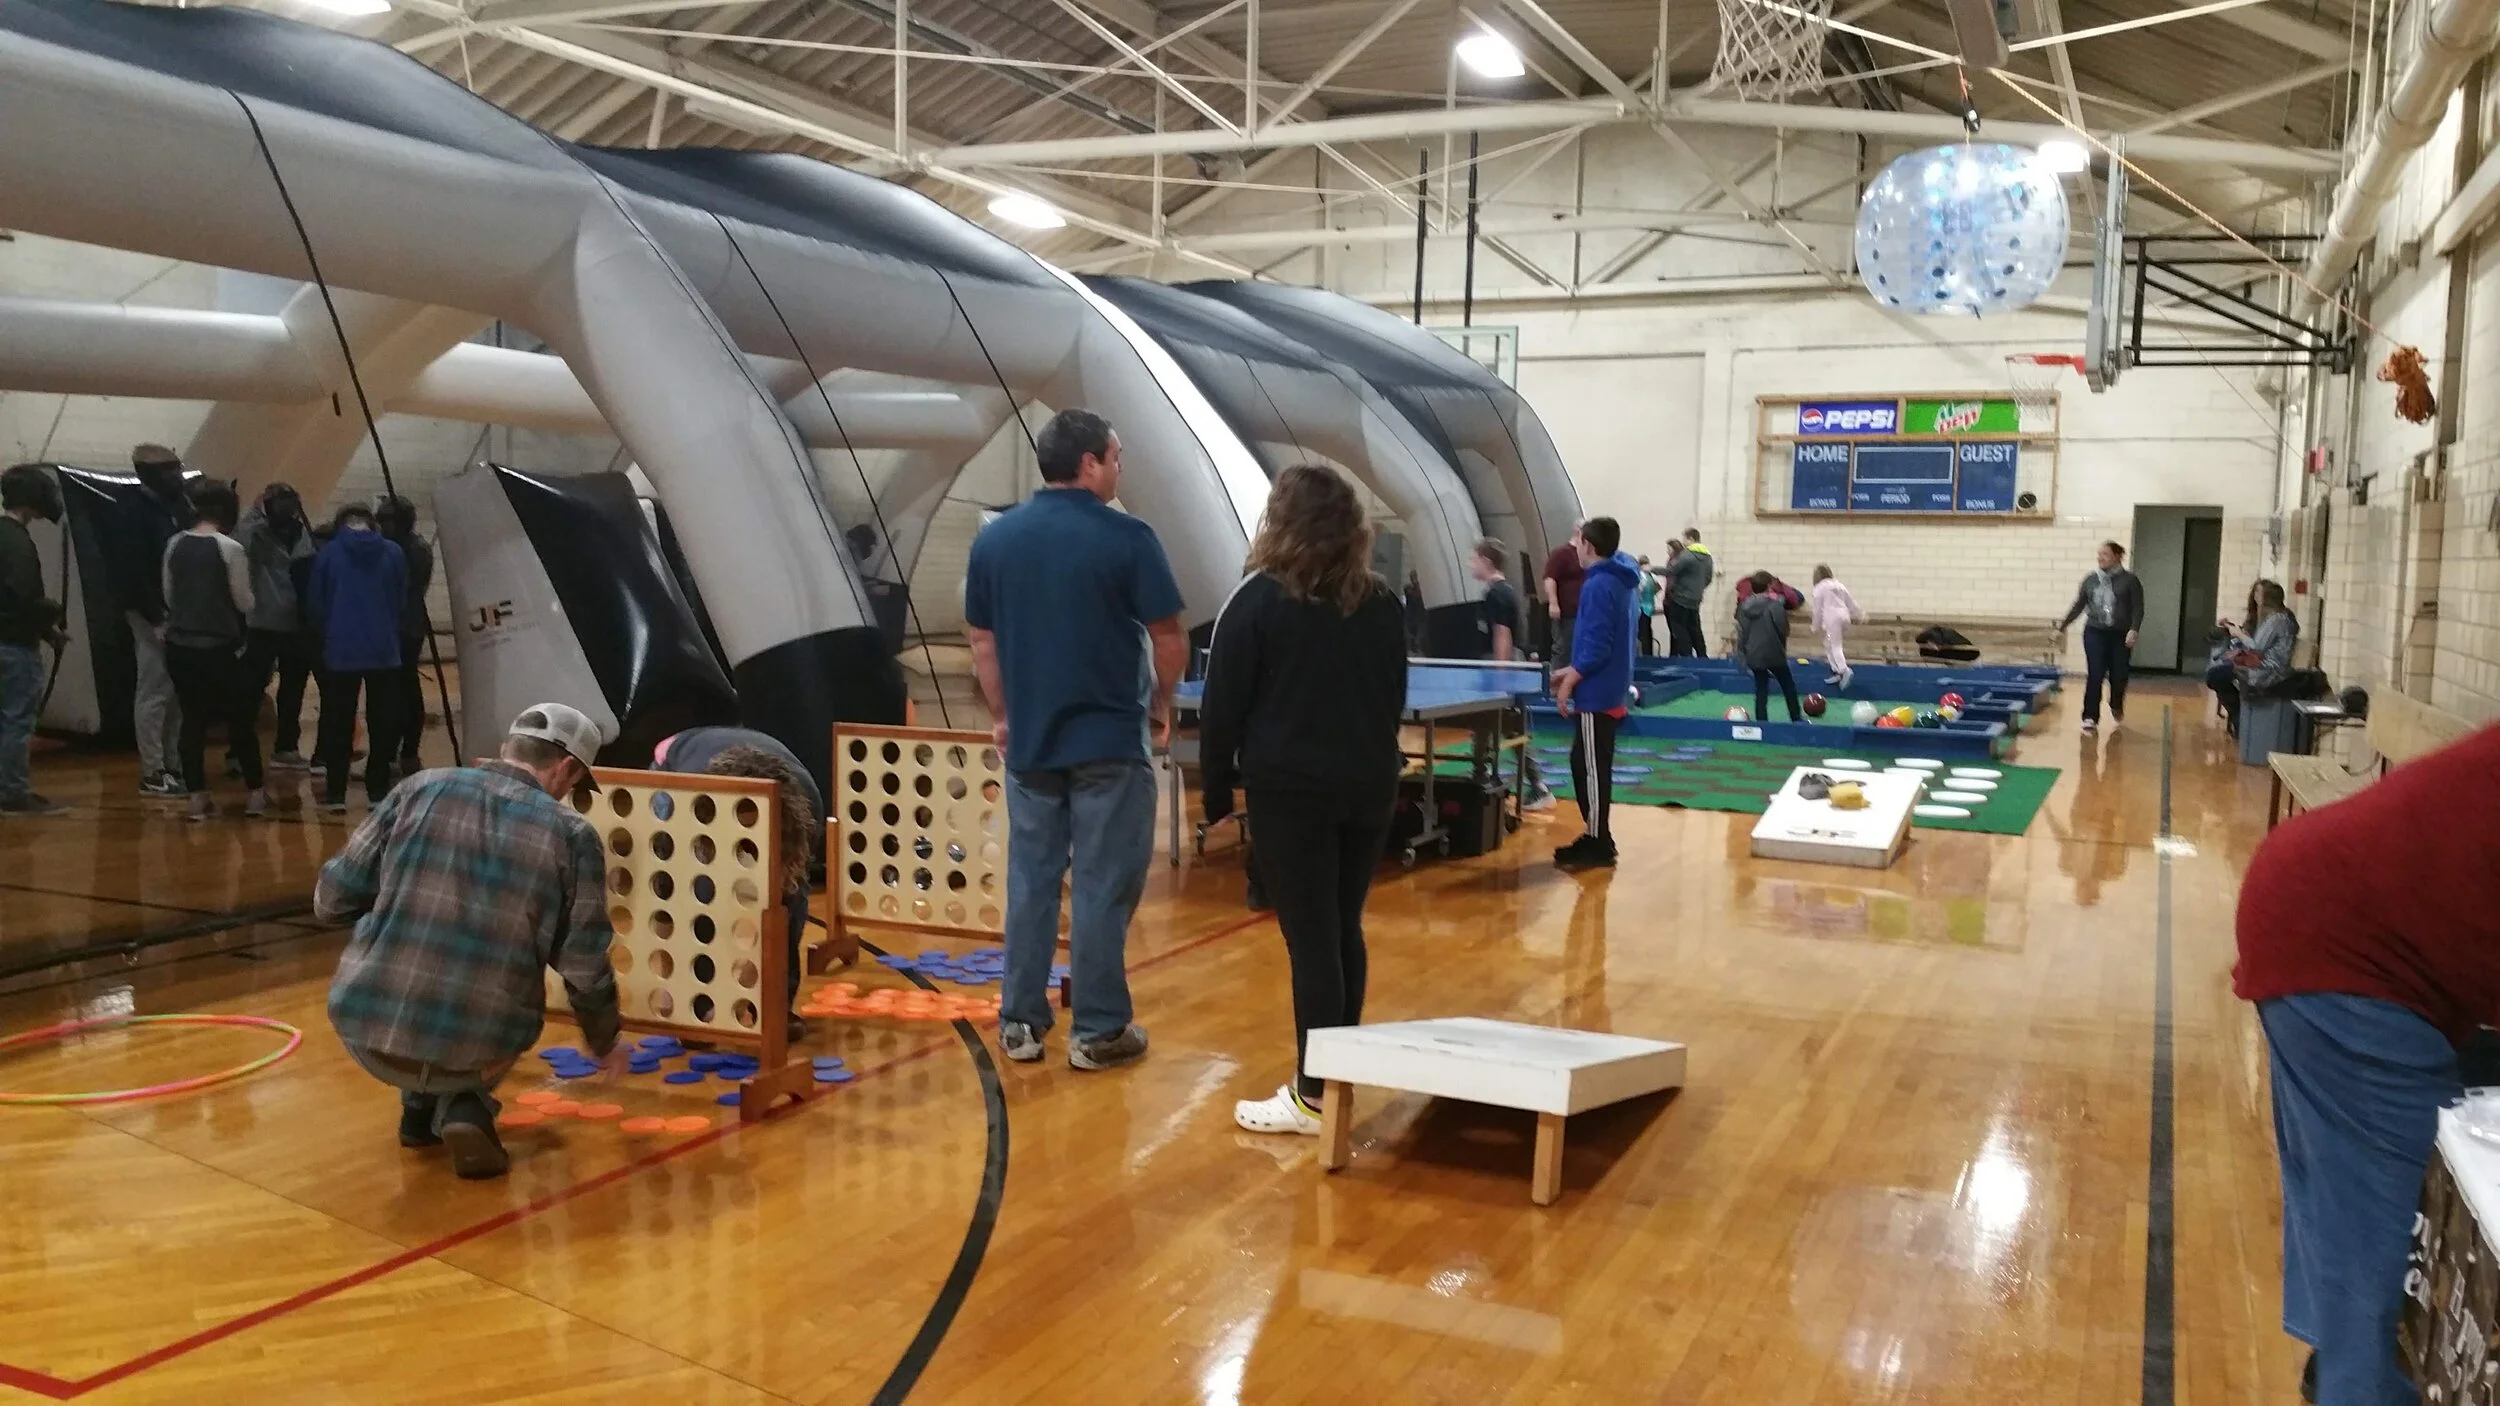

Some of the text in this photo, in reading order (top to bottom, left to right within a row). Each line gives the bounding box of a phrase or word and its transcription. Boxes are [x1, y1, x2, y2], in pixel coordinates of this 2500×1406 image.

[1824, 410, 1895, 430] PEPSI
[1798, 445, 1849, 462] HOME
[1960, 444, 2014, 462] GUEST
